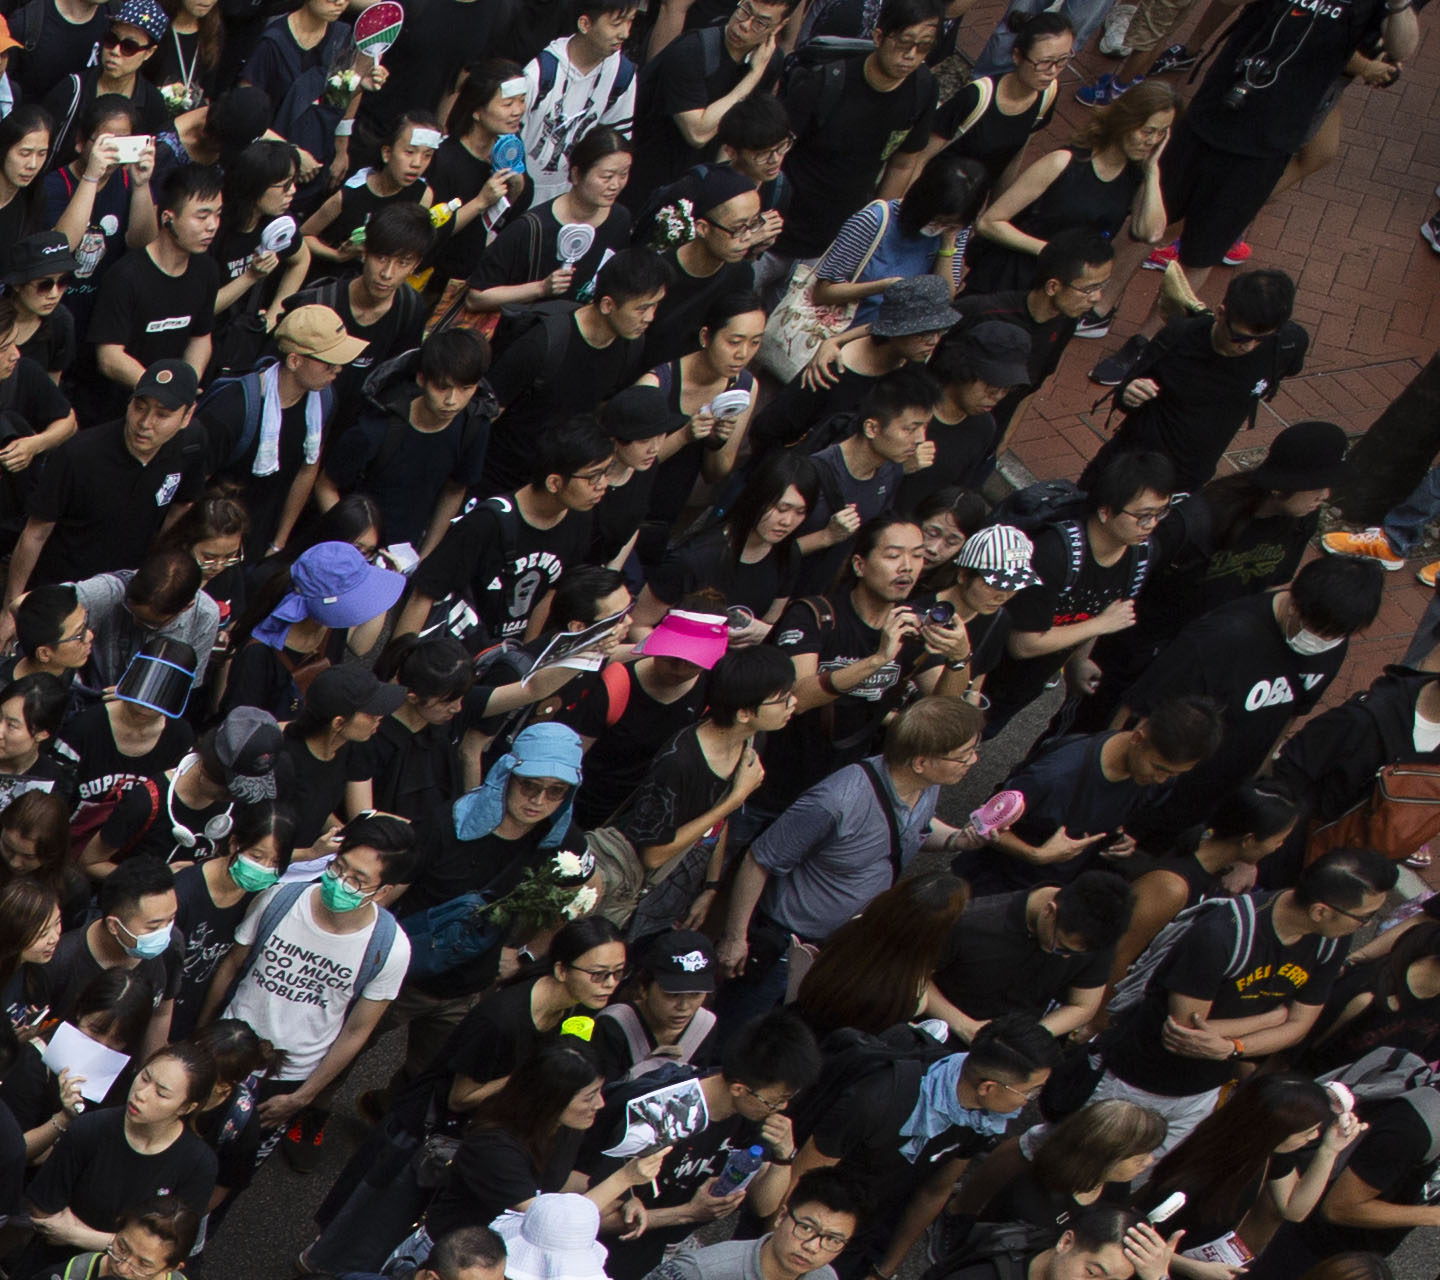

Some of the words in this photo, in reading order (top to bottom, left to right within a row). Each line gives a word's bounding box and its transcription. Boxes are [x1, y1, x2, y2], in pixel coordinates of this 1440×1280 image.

[270, 934, 352, 981] THINKING
[264, 964, 324, 995] CAUSES
[297, 962, 353, 993] MUCH
